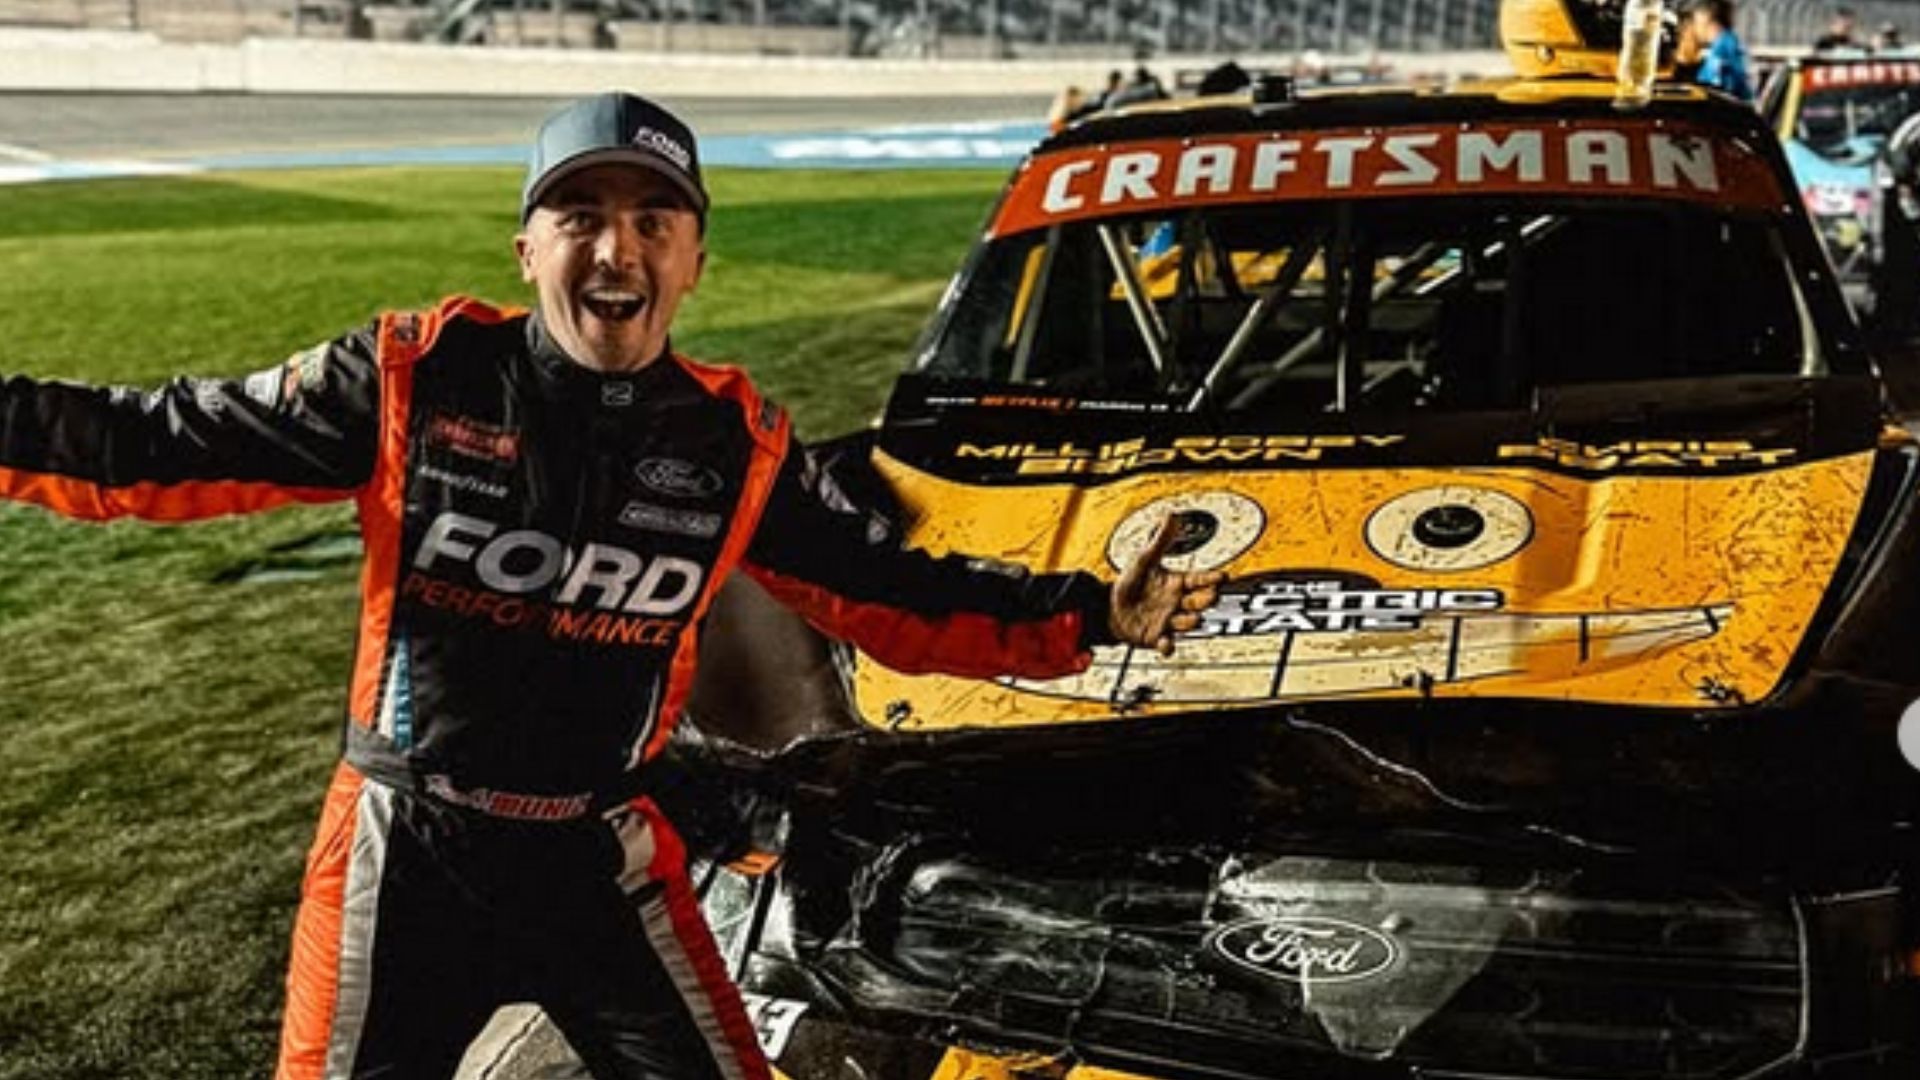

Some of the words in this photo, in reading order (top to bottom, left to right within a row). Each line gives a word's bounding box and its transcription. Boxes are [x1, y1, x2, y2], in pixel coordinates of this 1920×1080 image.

[1041, 128, 1720, 214] CRAFTSMAN
[413, 511, 703, 617] FORD
[400, 568, 682, 646] PERFOMANCE
[1245, 921, 1358, 974] Ford
